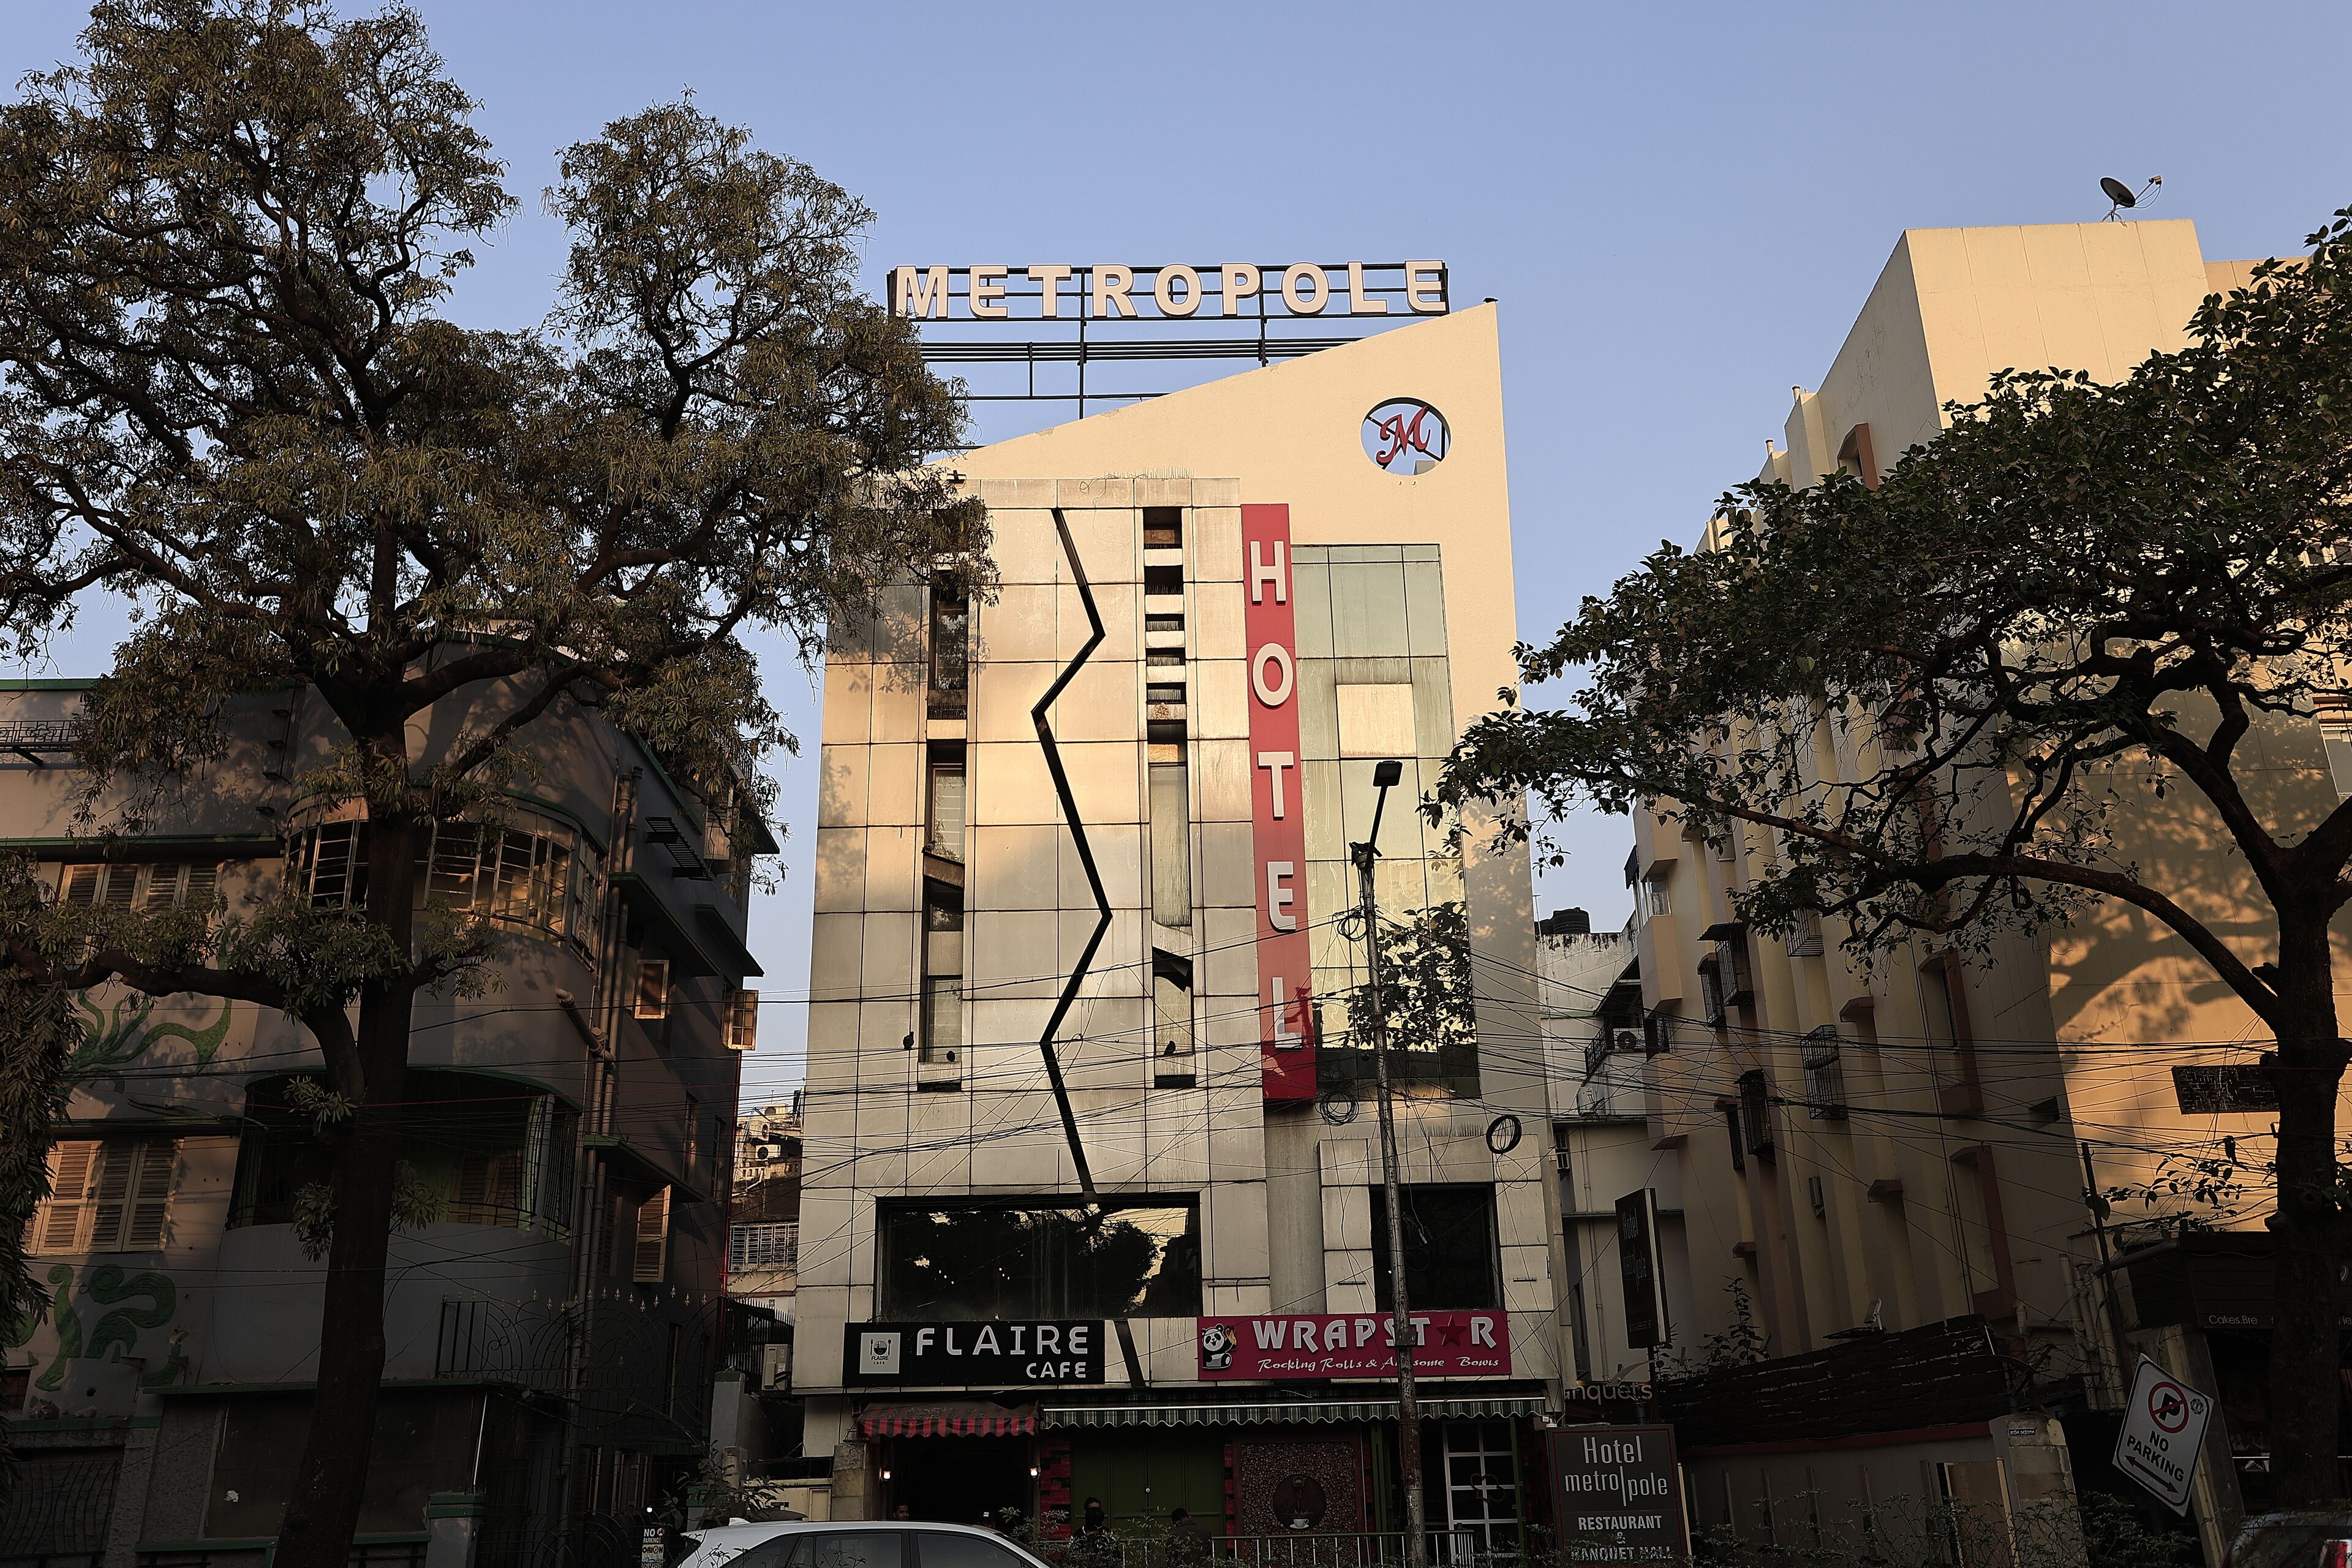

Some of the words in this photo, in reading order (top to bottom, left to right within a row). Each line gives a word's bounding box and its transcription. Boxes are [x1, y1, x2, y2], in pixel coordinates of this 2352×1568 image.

[895, 260, 1447, 318] METROPOLE
[1249, 540, 1302, 1051] HOTEL
[1621, 1207, 1639, 1240] Hotel
[916, 1324, 1089, 1355] FLAIRE
[1026, 1361, 1087, 1379] CAFE
[1257, 1358, 1316, 1373] Rocking
[1320, 1357, 1362, 1370] Rolls
[1366, 1359, 1378, 1368] &
[1380, 1355, 1445, 1370] Asome
[1583, 1434, 1643, 1464] Hotel
[2149, 1430, 2169, 1452] NO
[2127, 1434, 2184, 1482] PARKING
[644, 1528, 655, 1537] NO
[1578, 1515, 1662, 1531] RESTAURANT
[1616, 1531, 1627, 1544] &
